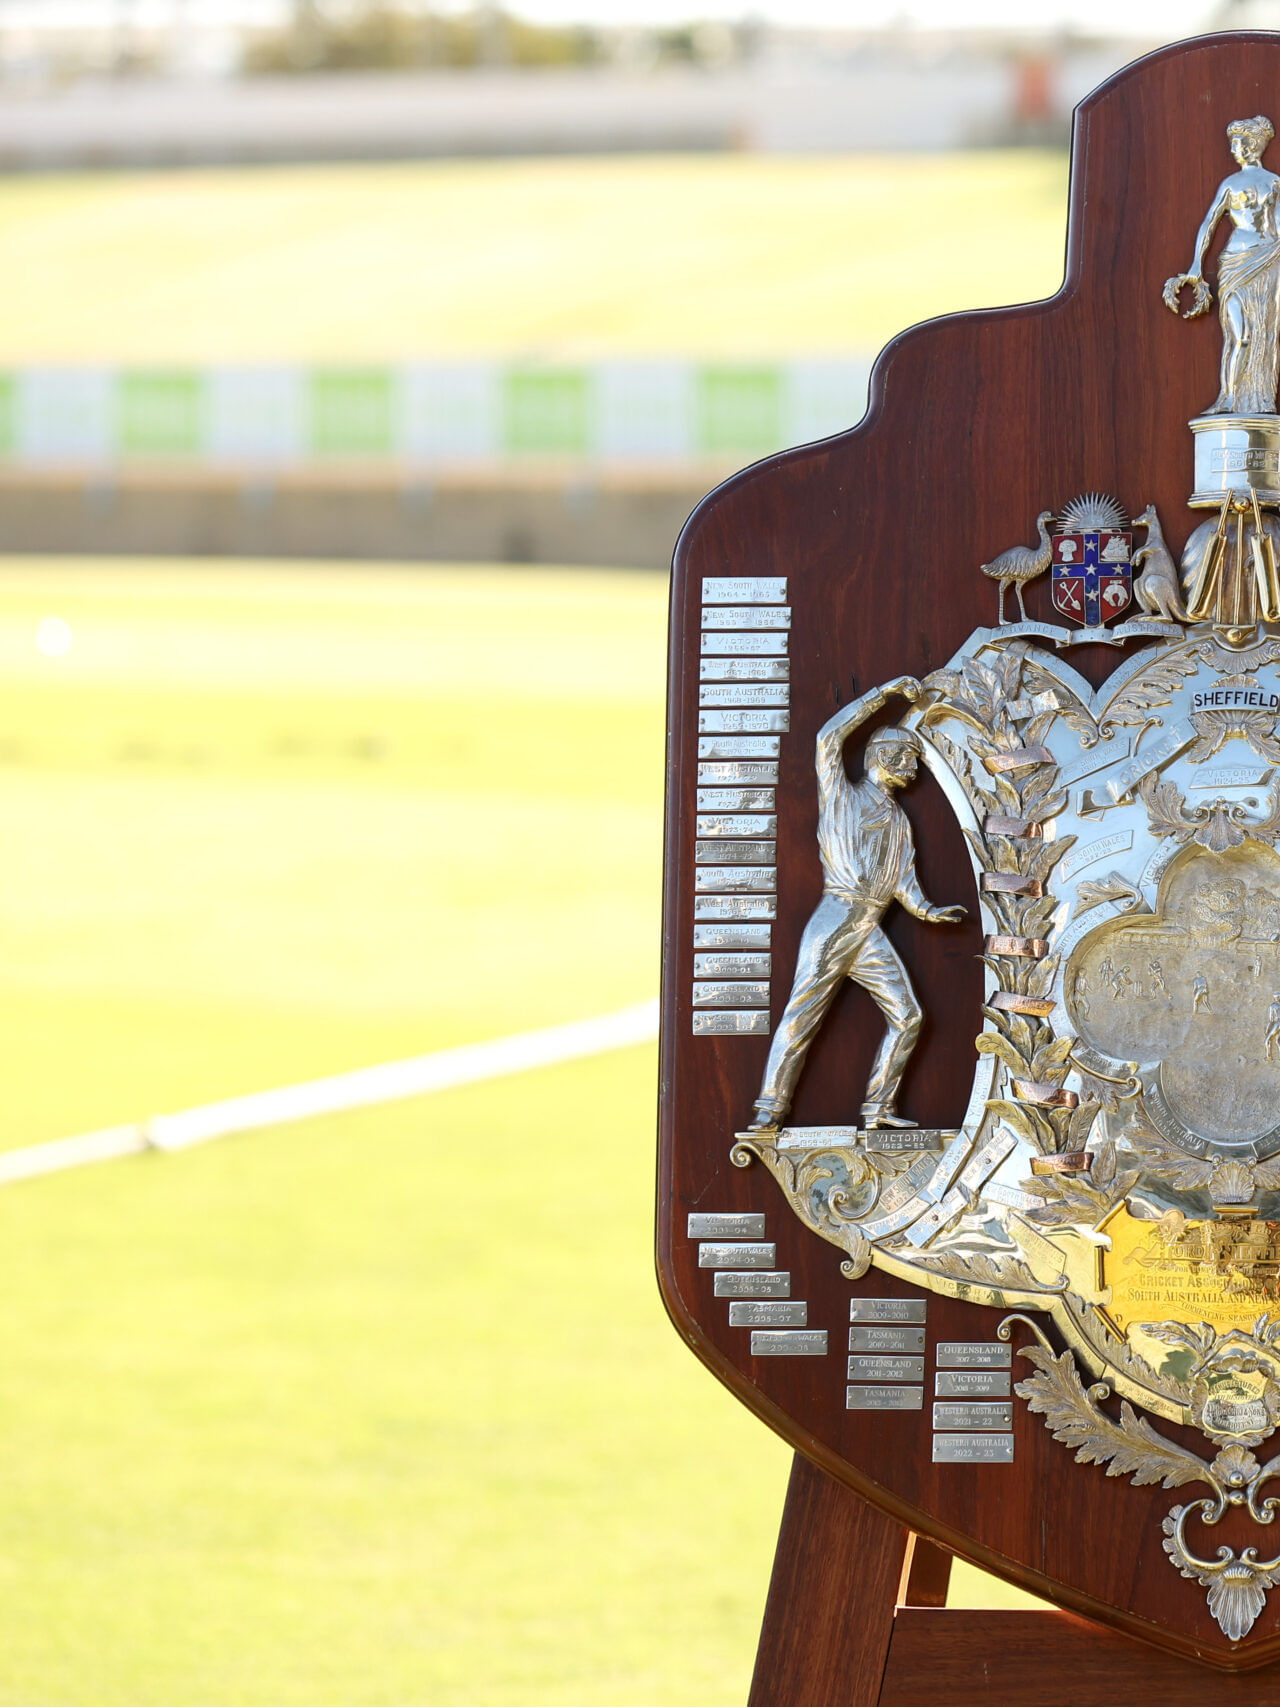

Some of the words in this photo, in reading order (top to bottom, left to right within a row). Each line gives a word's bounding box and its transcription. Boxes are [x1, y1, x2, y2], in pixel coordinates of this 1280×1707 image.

[728, 581, 753, 590] SOUTH
[706, 611, 726, 619] NEW
[729, 609, 754, 618] SOUTH
[759, 610, 787, 618] WALES
[703, 688, 733, 697] SOUTH
[735, 687, 786, 696] AUSTRALIA
[1194, 690, 1279, 708] SHEFFIELD
[720, 712, 768, 722] VICTORIA
[1208, 770, 1258, 778] VICTORIA
[712, 817, 761, 825] VICTORIA
[1100, 836, 1126, 849] WALES
[1140, 842, 1171, 888] VICTORIA
[705, 956, 762, 964] QUEENSLAND
[702, 985, 760, 993] QUEENSLAND
[876, 1133, 932, 1143] VICTORIA
[727, 1275, 781, 1284] QUEENSLAND
[1140, 1276, 1184, 1288] CRICKET
[1128, 1288, 1160, 1301] SOUTH
[1163, 1290, 1227, 1303] AUSTRALIA
[1229, 1293, 1245, 1304] AND
[1248, 1293, 1268, 1304] NEW
[871, 1301, 907, 1310] VICTORIA
[1181, 1302, 1225, 1320] COMMENCING
[1228, 1312, 1258, 1321] SEASON
[866, 1330, 905, 1339] TASMANIA
[943, 1346, 1004, 1354] QUEENSLAND
[859, 1358, 912, 1368] QUEENSLAND
[950, 1374, 993, 1383] VICTORIA
[864, 1388, 906, 1397] TASMANIA
[941, 1407, 969, 1415] WESTERN
[970, 1407, 1008, 1415] AUSTRALIA
[982, 1417, 993, 1426] 22
[940, 1439, 969, 1447] WESTERN
[971, 1439, 1009, 1447] AUSTRALIA
[953, 1449, 973, 1457] 2022
